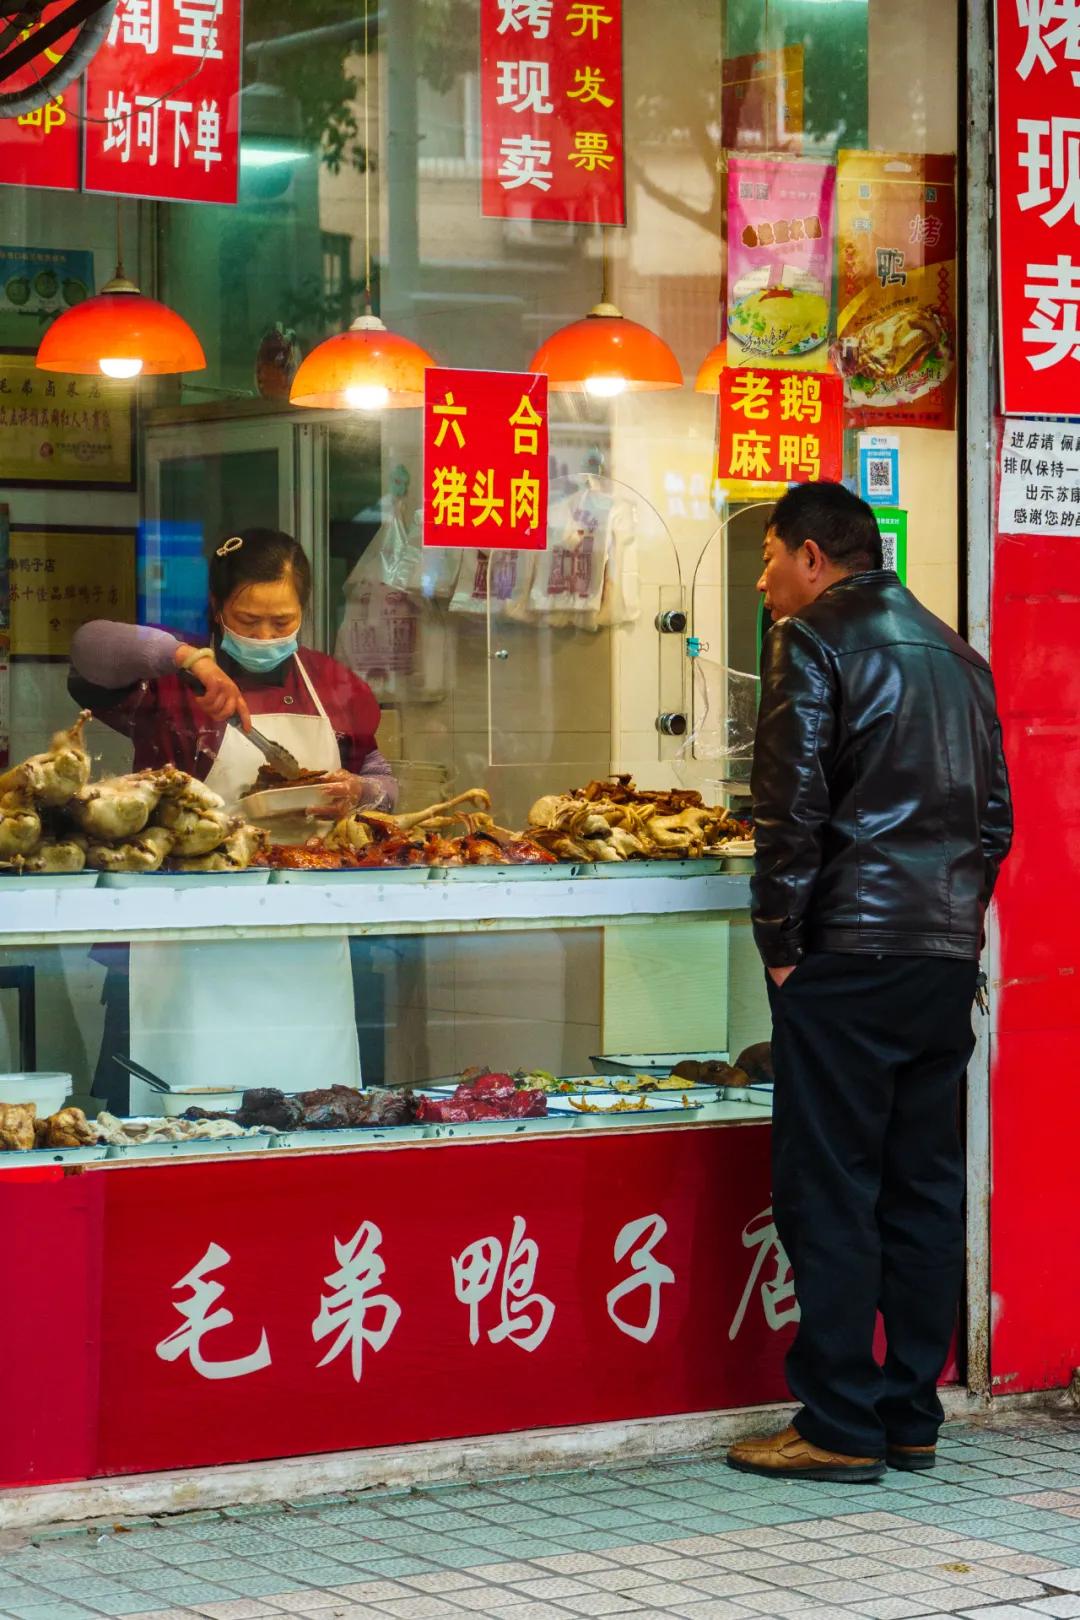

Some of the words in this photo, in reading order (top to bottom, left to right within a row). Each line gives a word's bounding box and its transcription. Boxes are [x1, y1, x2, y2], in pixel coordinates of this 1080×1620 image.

[106, 0, 223, 60] 淘宝
[496, 0, 554, 192] 烤现卖
[566, 3, 615, 172] 开发票
[103, 90, 222, 173] 均可下单
[432, 391, 543, 456] 六合
[730, 371, 822, 424] 老鹅
[728, 430, 820, 482] 麻鸭
[1004, 456, 1079, 478] 排队保持一
[431, 466, 541, 530] 猪头肉
[155, 1192, 801, 1383] 毛弟鸭子店
